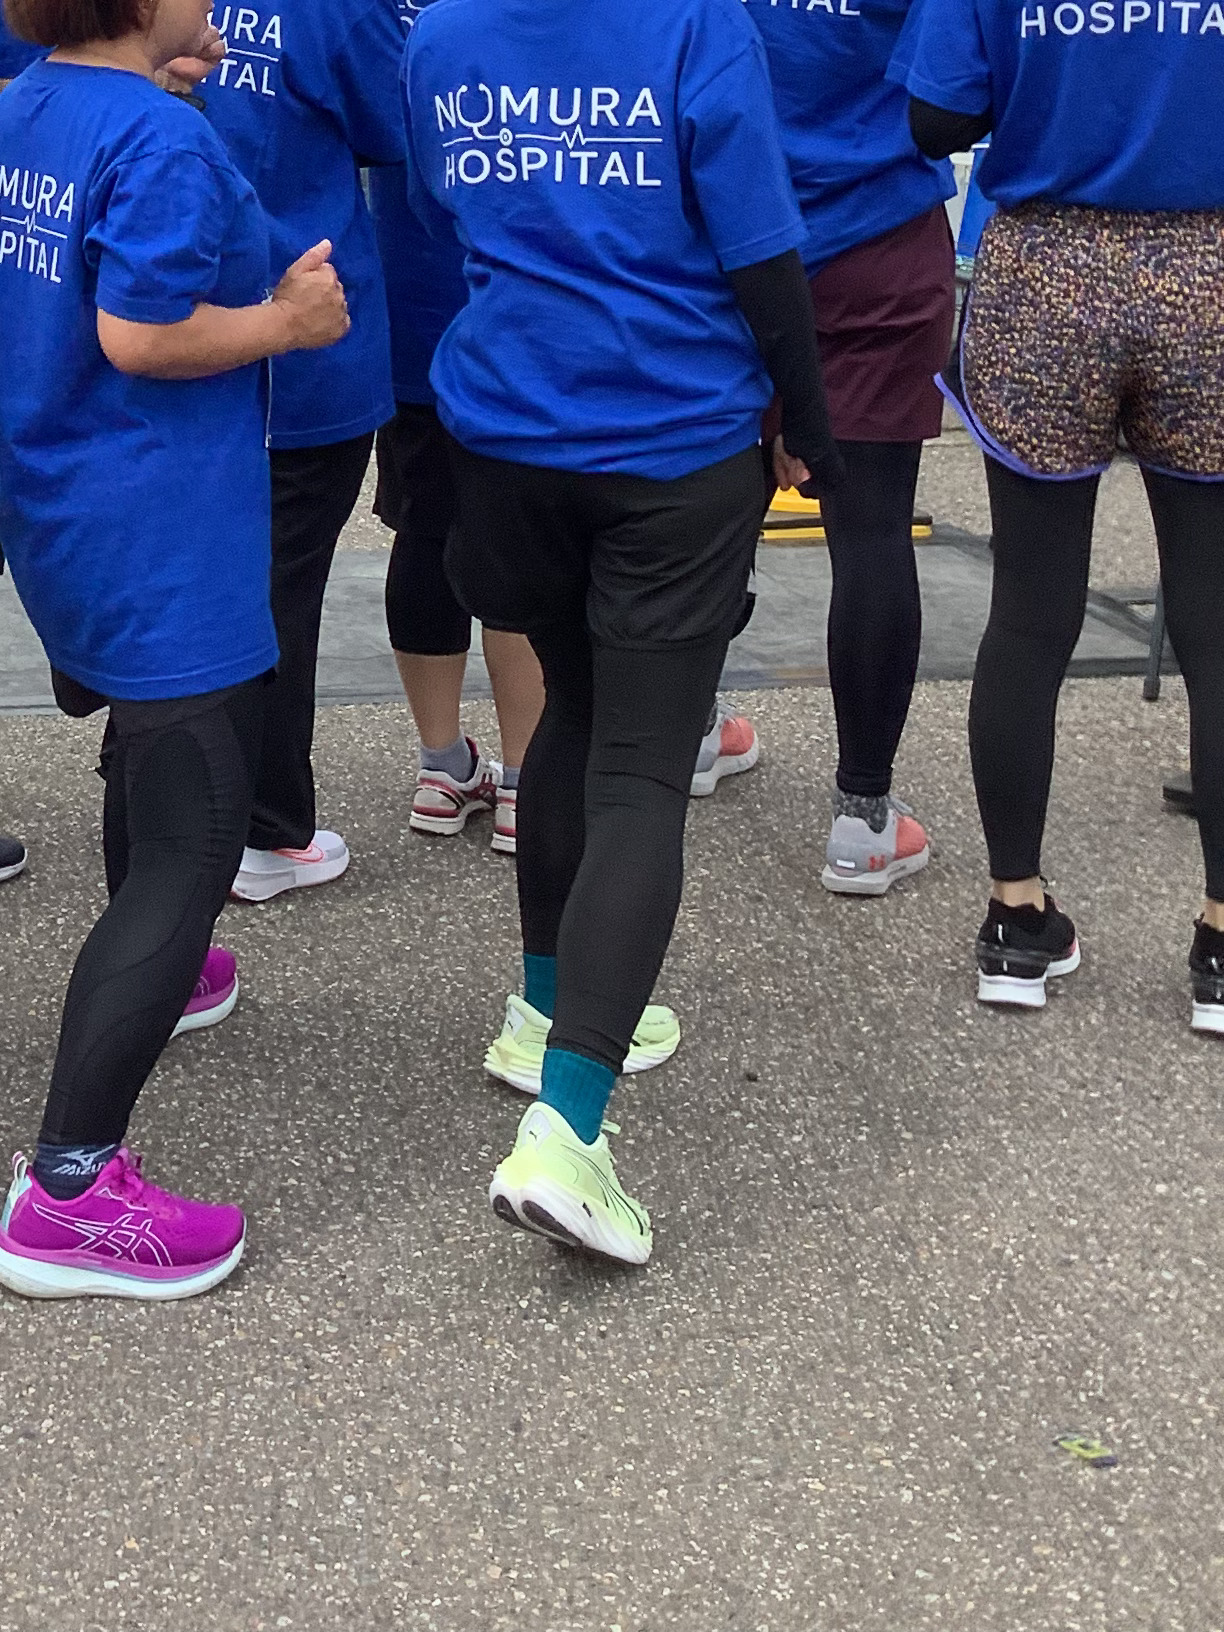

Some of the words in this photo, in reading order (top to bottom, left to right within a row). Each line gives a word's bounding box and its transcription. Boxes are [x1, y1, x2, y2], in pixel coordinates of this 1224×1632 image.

[207, 5, 282, 49] URA
[1020, 0, 1224, 38] HOSPITA
[434, 82, 662, 132] NOMURA
[444, 147, 662, 189] HOSPITAL
